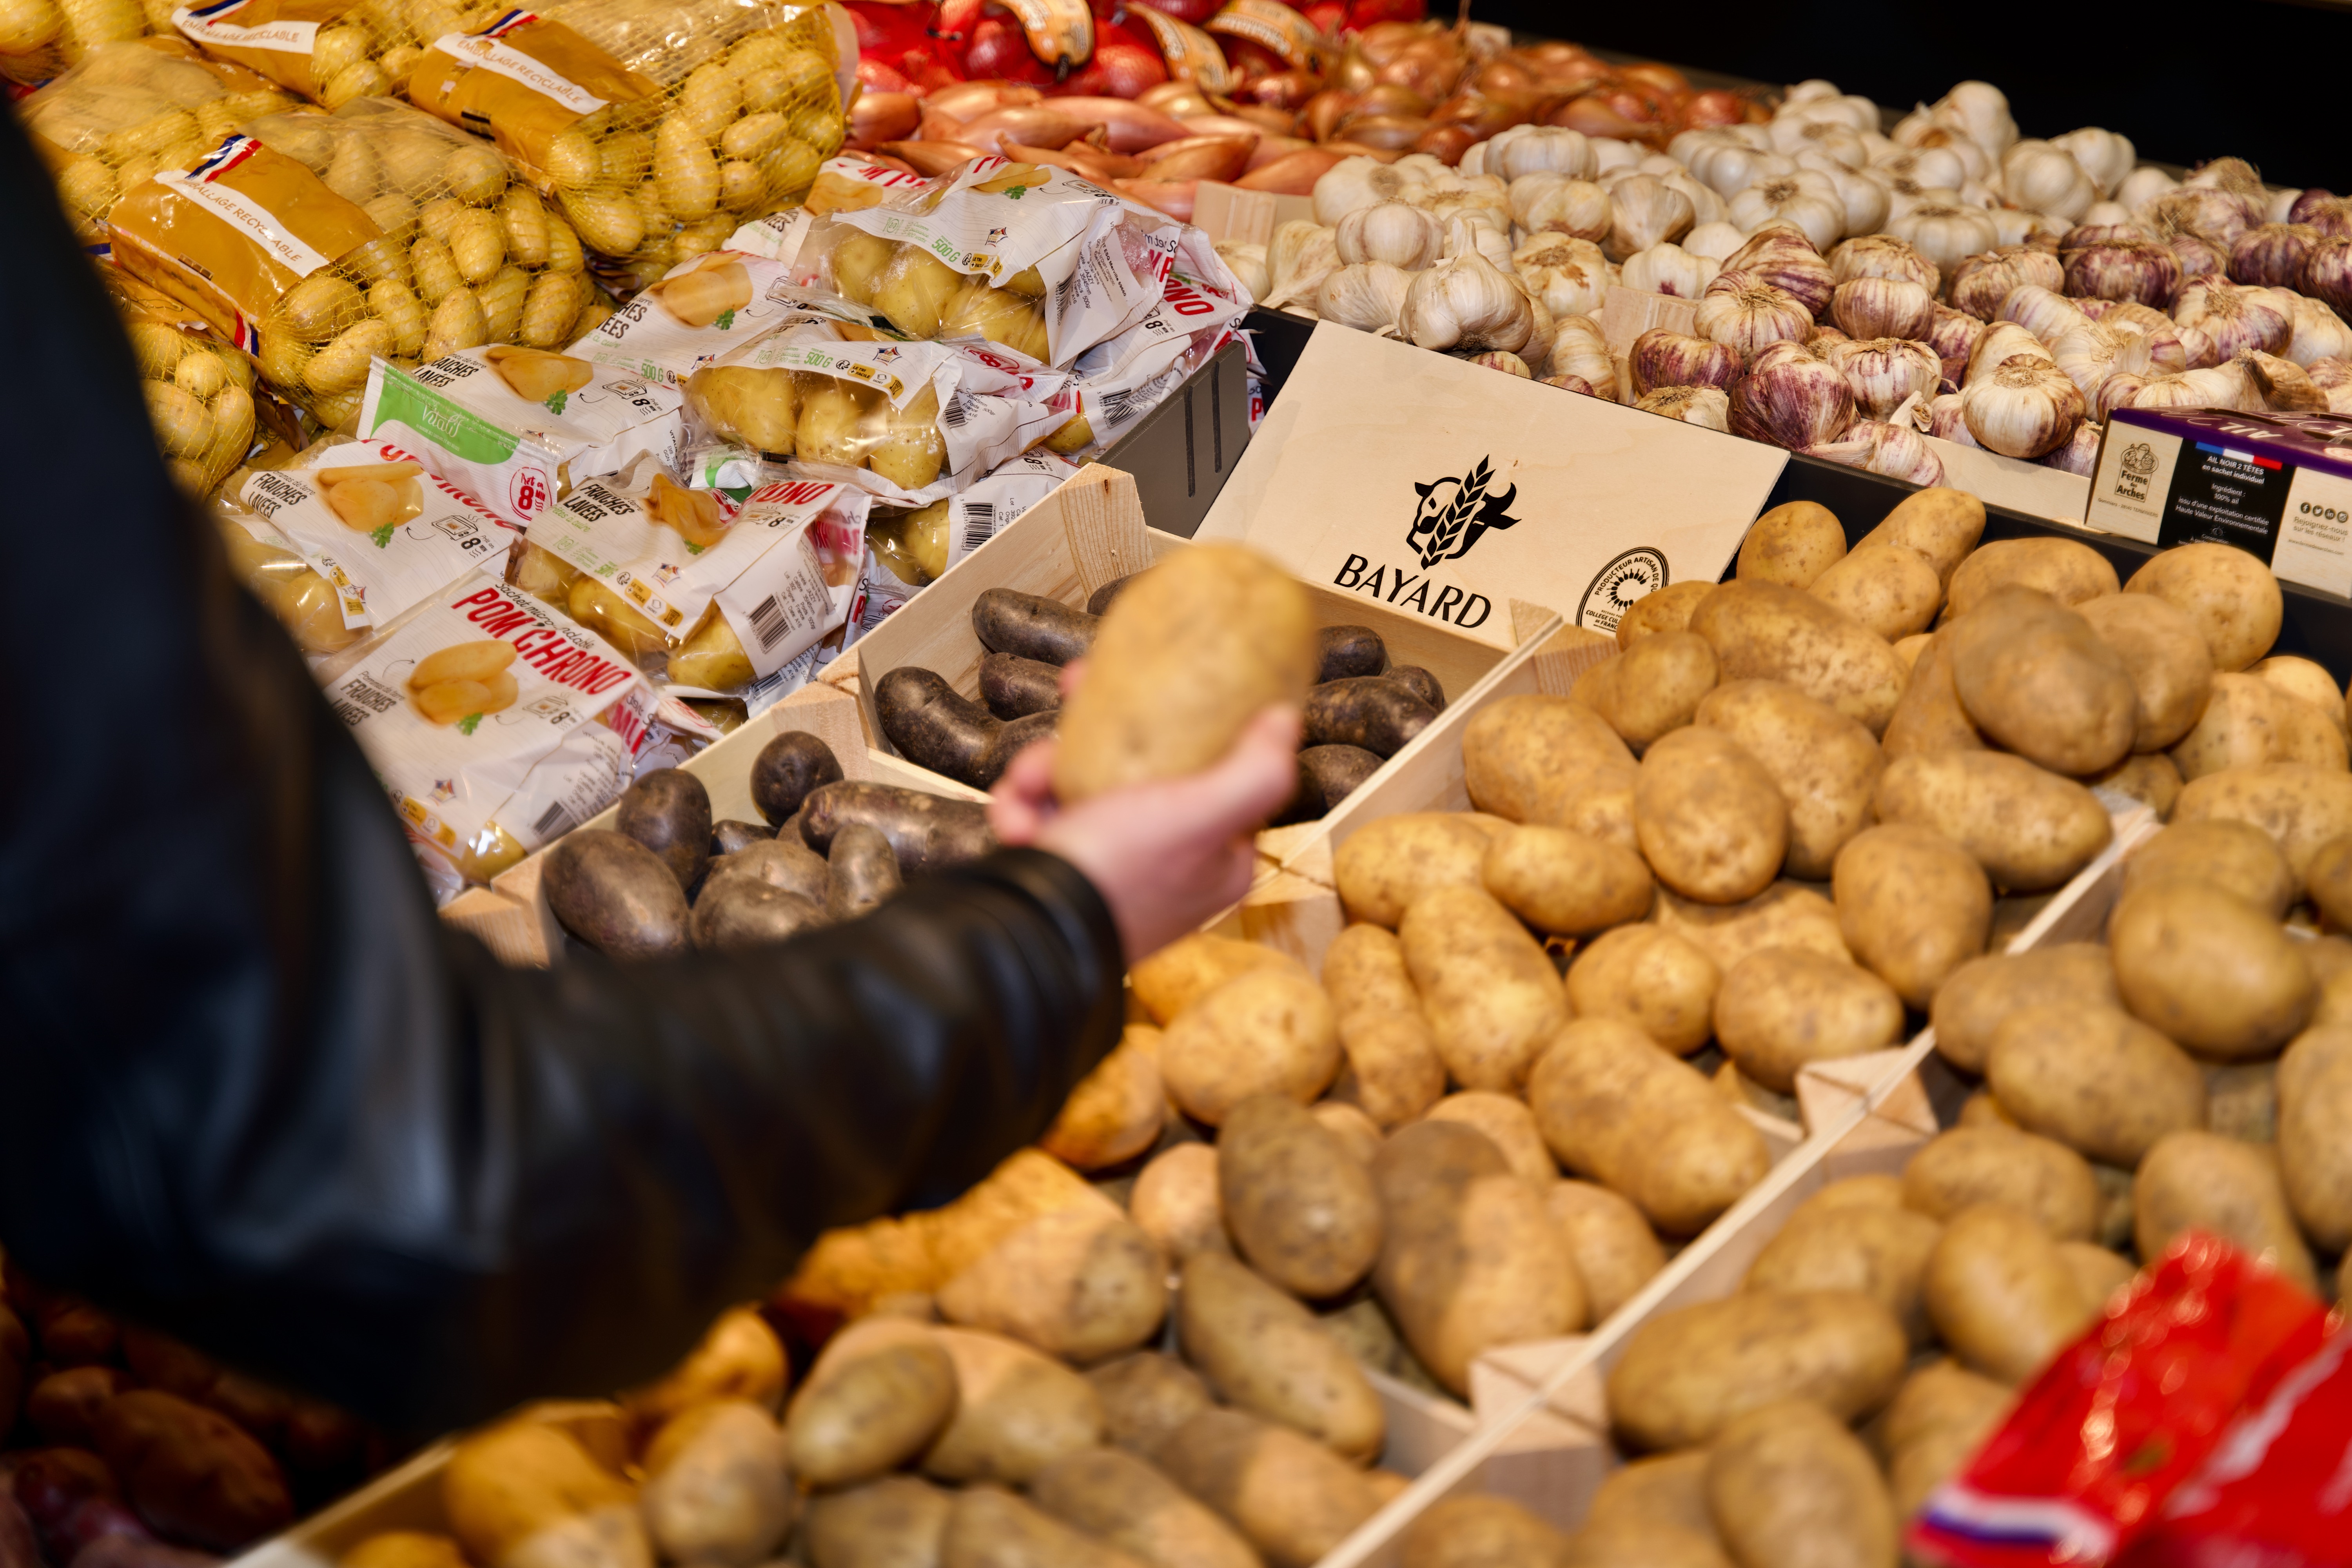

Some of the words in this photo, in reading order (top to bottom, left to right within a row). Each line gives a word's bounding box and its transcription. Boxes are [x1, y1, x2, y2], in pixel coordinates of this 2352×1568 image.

[517, 65, 583, 104] RECYCLABLE
[931, 238, 953, 257] 500
[948, 252, 960, 262] G
[1084, 268, 1095, 284] JAZZY
[1109, 260, 1119, 281] Merville
[1080, 272, 1092, 295] 35/45mm
[637, 296, 653, 306] terre
[1145, 321, 1163, 329] 8
[601, 338, 621, 348] cuire
[471, 360, 486, 369] terre
[804, 351, 824, 367] 500
[822, 356, 833, 368] G
[979, 354, 1001, 368] 8
[641, 363, 656, 380] 500
[658, 368, 663, 382] G
[962, 402, 978, 413] France
[966, 393, 987, 407] 35/45mm
[967, 399, 979, 409] Poids
[982, 407, 996, 416] 500gr
[2207, 456, 2219, 464] AIL
[2220, 459, 2238, 468] NOIR
[2243, 463, 2265, 475] TÊTES
[521, 473, 536, 486] Prêt
[537, 481, 544, 490] en
[2121, 470, 2149, 485] Ferme
[2212, 465, 2233, 476] sachet
[2234, 471, 2265, 485] individuel
[253, 473, 307, 505] FRAICHES
[300, 485, 316, 495] terre
[518, 485, 534, 510] 8
[535, 492, 545, 502] MIN
[2116, 485, 2145, 500] Arches
[2211, 483, 2243, 497] Ingrédient
[248, 491, 282, 519] LAVÉES
[579, 483, 635, 515] FRAICHES
[2214, 493, 2230, 503] 100%
[563, 495, 608, 522] LAVÉES
[2133, 507, 2159, 518] TERMINIERS
[2178, 496, 2191, 505] issu
[2192, 500, 2209, 509] d'une
[2209, 505, 2244, 519] exploitation
[2244, 514, 2270, 526] certifiée
[572, 520, 591, 532] cuire
[768, 517, 786, 527] 8
[2176, 505, 2194, 515] Haute
[2194, 510, 2214, 519] Valeur
[2214, 515, 2269, 535] Environnementale
[2294, 516, 2349, 536] Rejoignez-nous
[461, 537, 481, 549] 8
[481, 534, 490, 544] Prêt
[2305, 527, 2315, 535] les
[2316, 530, 2341, 541] réseaux
[479, 544, 487, 552] MIN
[1595, 559, 1632, 595] PRODUCTEUR
[1633, 557, 1658, 573] ARTISAN
[1652, 572, 1659, 581] DE
[797, 569, 806, 586] Variété
[806, 588, 817, 603] JAZZY
[1333, 554, 1491, 628] BAYARD
[495, 583, 527, 608] Sachet
[632, 591, 646, 603] FACILE
[786, 586, 795, 603] Origine
[795, 604, 805, 621] France
[793, 576, 803, 592] Calibre
[802, 593, 815, 615] 35/45mm
[808, 617, 816, 630] 500gr
[1586, 610, 1608, 620] COLLEGE
[787, 669, 795, 680] A16
[358, 670, 385, 692] Pommes
[384, 684, 392, 694] de
[390, 687, 405, 701] terre
[340, 678, 397, 713] FRAICHES
[332, 697, 370, 726] LAVÉES
[550, 711, 570, 724] 8
